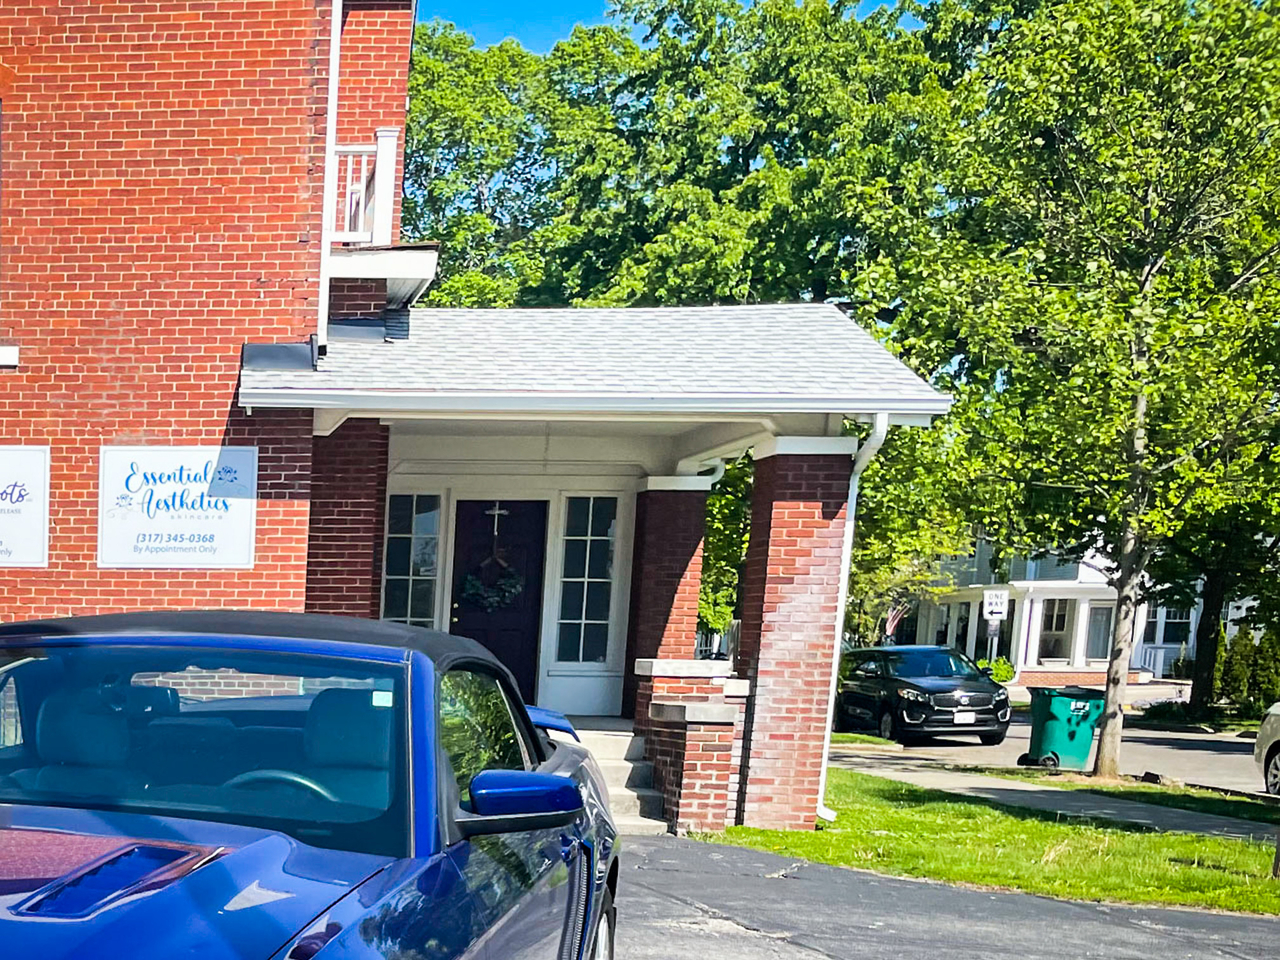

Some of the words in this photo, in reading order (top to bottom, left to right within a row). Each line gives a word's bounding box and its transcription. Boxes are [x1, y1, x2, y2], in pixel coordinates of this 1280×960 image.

[125, 460, 213, 494] Essential
[136, 488, 232, 519] Aesthetics
[136, 533, 163, 544] (317)
[165, 533, 215, 544] 345-0368
[133, 545, 144, 554] By
[144, 545, 197, 554] Appointment
[199, 545, 218, 555] Only
